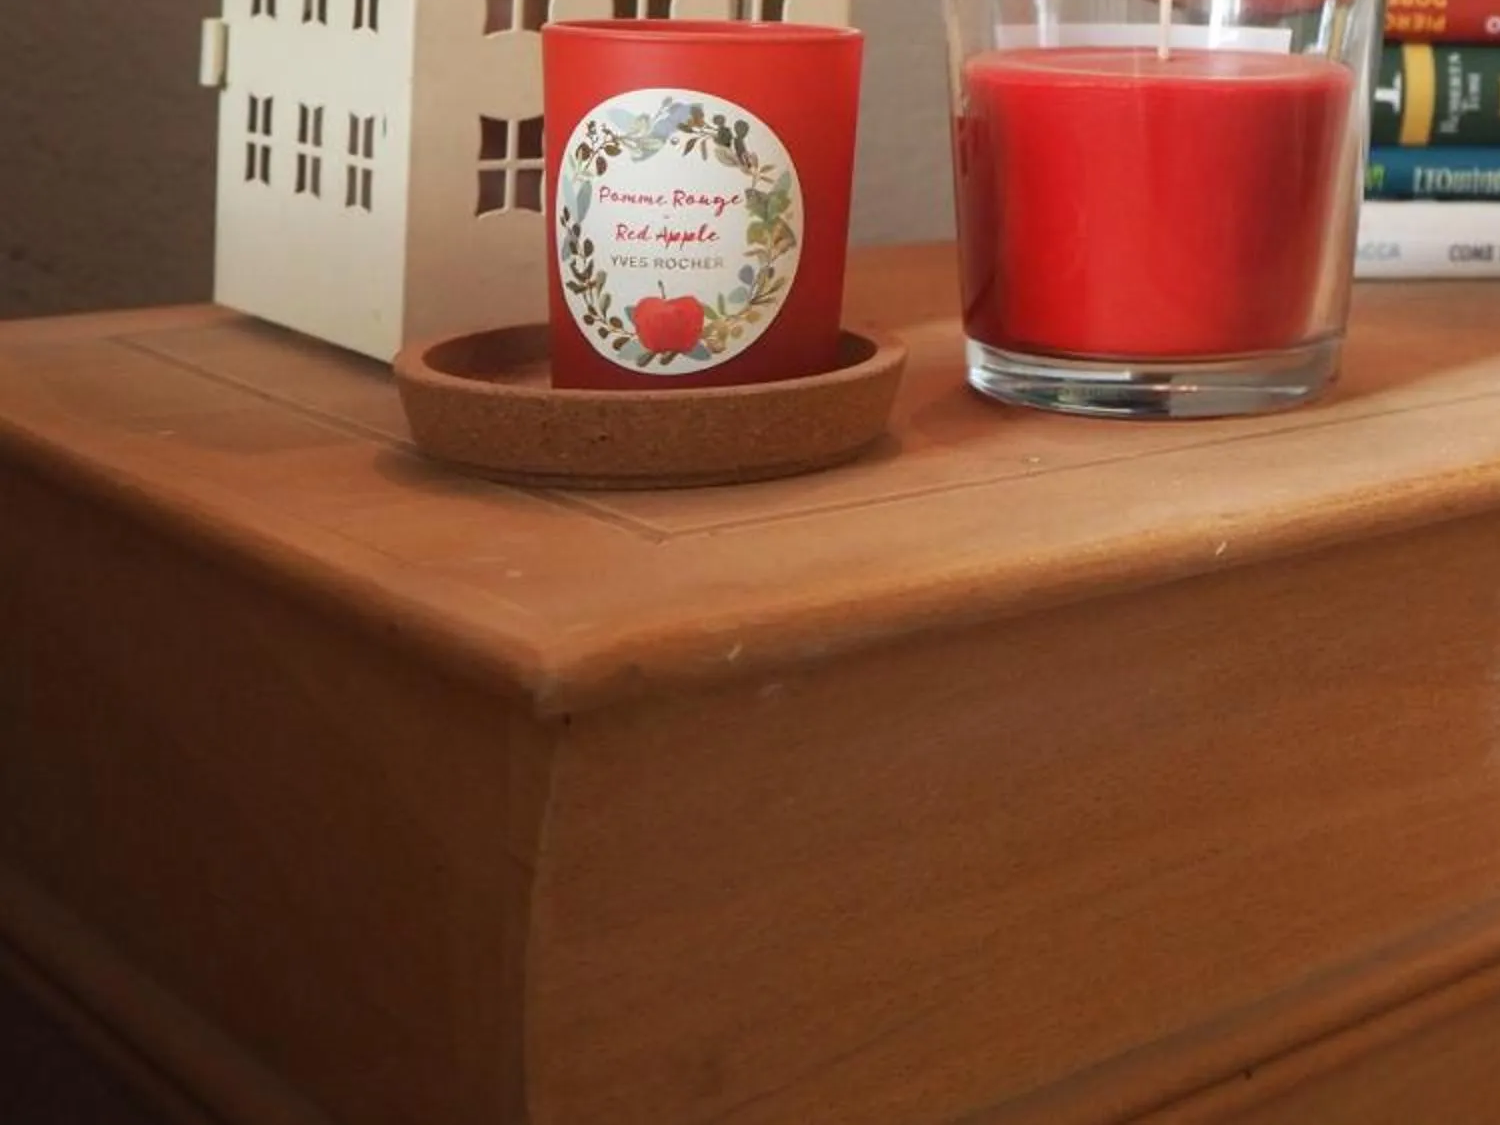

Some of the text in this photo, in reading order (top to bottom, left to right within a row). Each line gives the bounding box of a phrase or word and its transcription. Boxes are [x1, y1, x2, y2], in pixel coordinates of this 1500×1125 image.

[599, 186, 743, 217] Pomme Rouge
[615, 223, 720, 251] Red Apple
[611, 254, 724, 270] YVES ROCHER
[1449, 243, 1494, 262] COME
